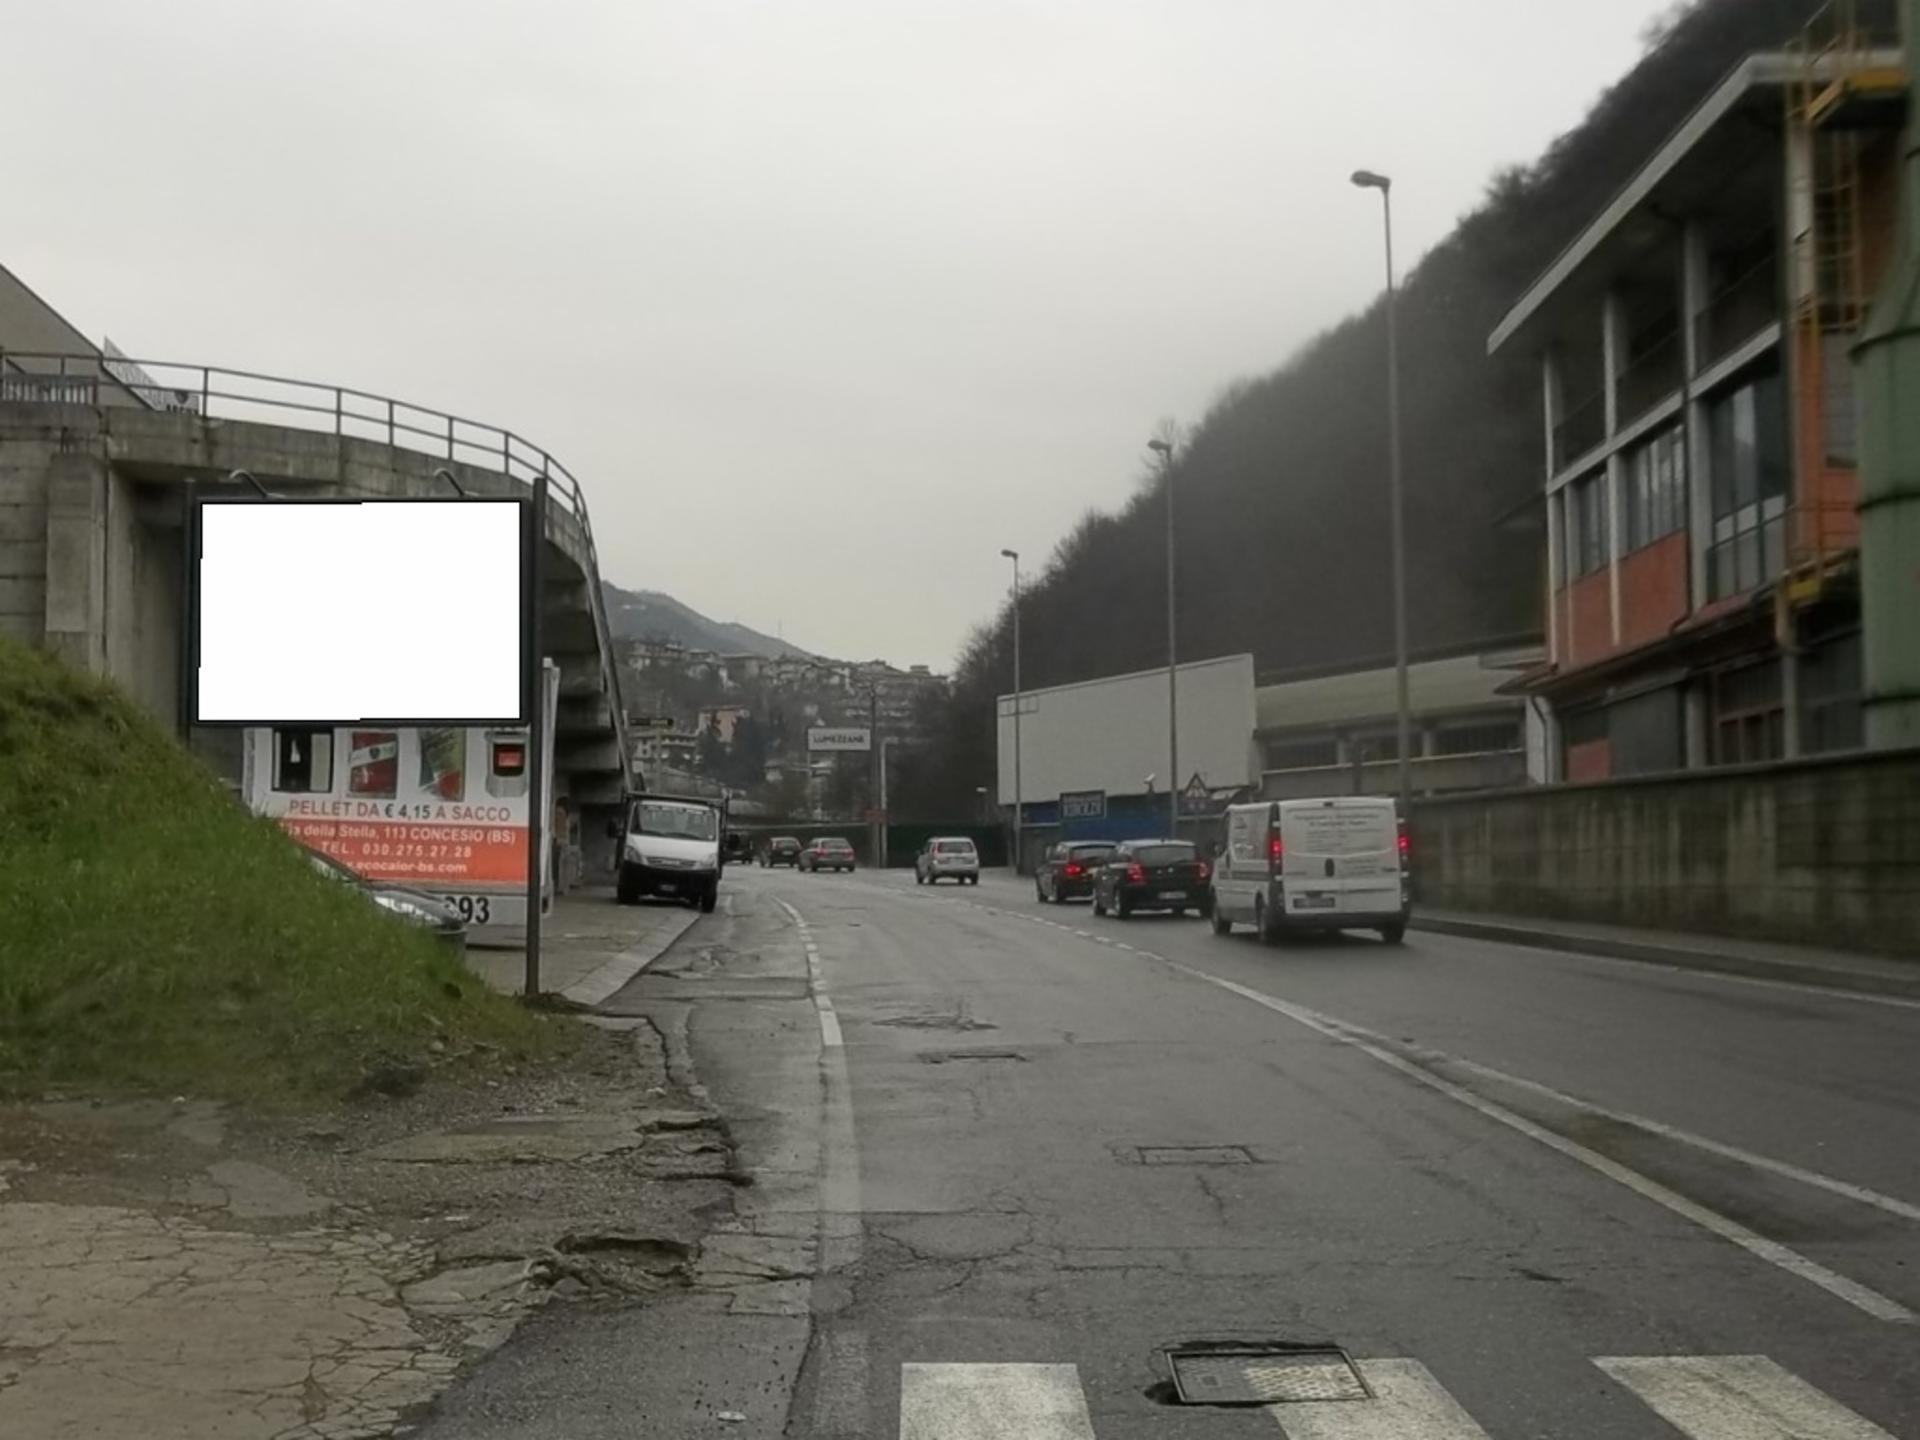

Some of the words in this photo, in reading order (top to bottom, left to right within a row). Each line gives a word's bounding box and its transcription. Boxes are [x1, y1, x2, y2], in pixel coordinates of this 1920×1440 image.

[289, 800, 352, 817] PELLET
[357, 803, 380, 818] DA
[385, 803, 394, 818] €
[399, 804, 431, 820] 4,15
[436, 806, 446, 819] A
[452, 806, 511, 822] SACCO
[303, 823, 336, 837] della
[385, 826, 406, 839] 113
[410, 828, 484, 842] CONCESIO
[487, 829, 516, 845] (BS)
